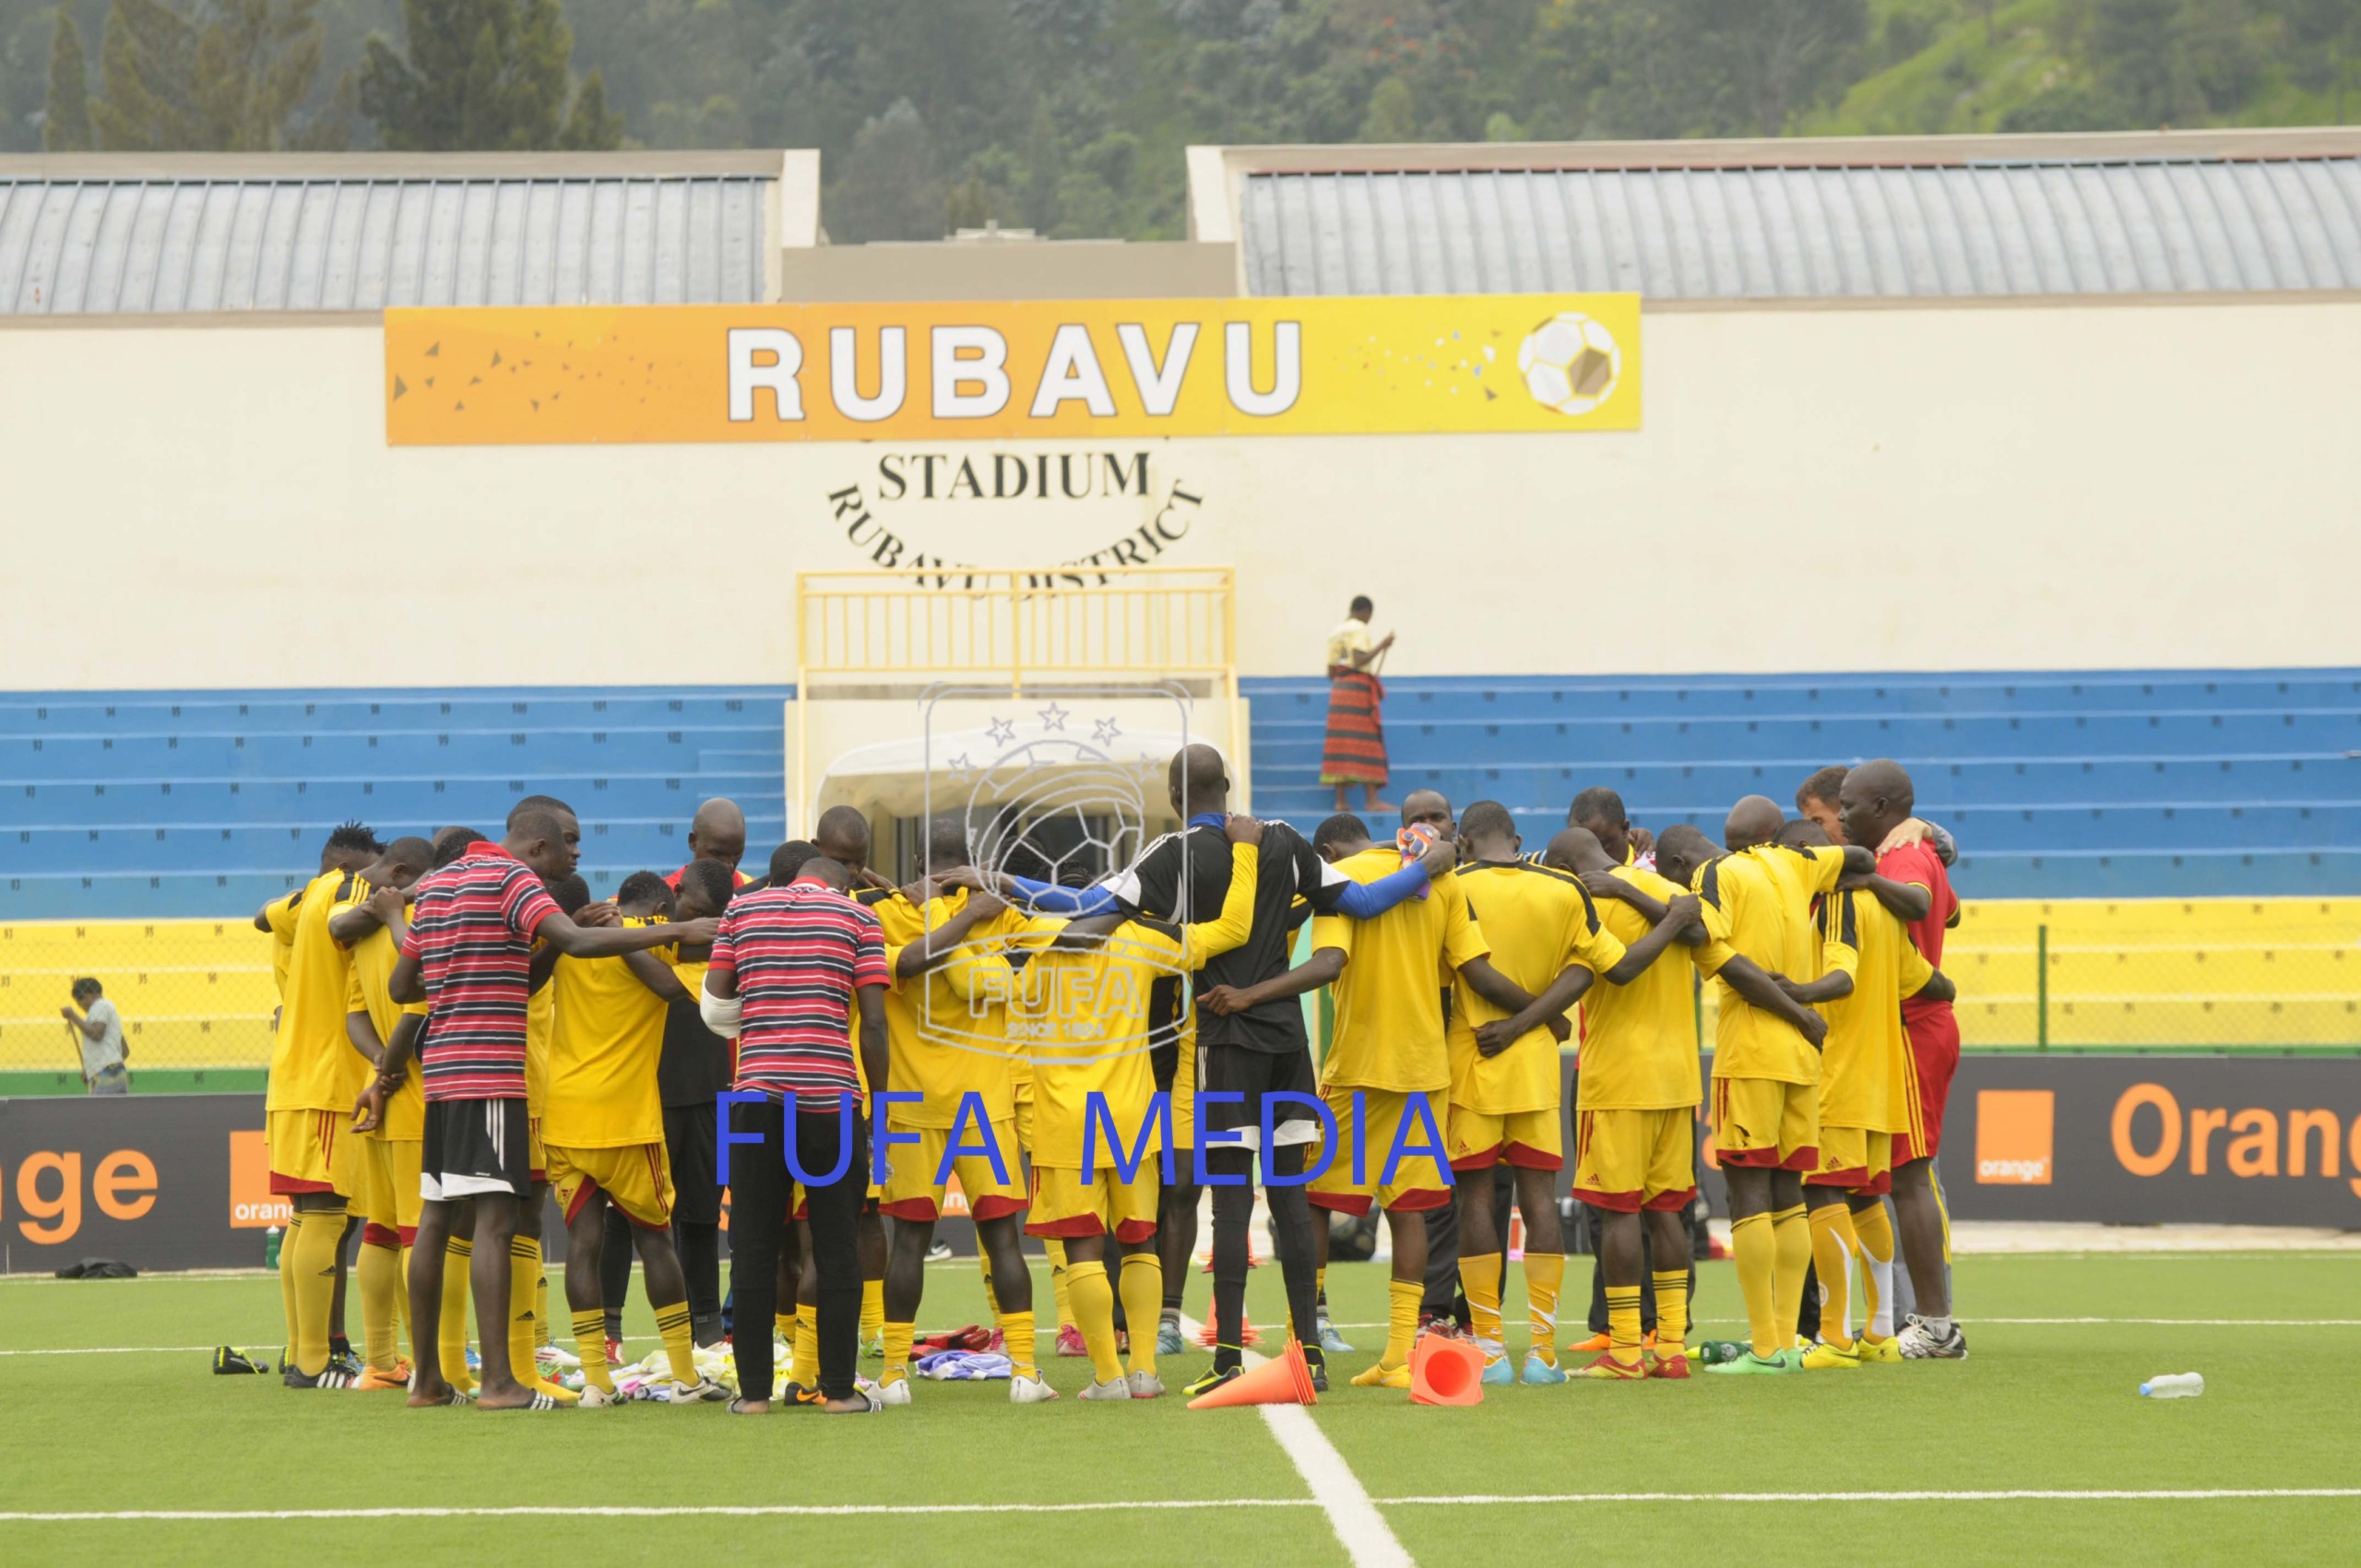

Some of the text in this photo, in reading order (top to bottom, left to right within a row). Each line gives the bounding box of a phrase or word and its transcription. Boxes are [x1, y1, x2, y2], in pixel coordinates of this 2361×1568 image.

[727, 321, 1302, 422] RUBAVU
[877, 452, 1152, 500] STADIUM
[1979, 1159, 2046, 1182] orange
[2110, 1082, 2361, 1200] Oran
[0, 1149, 159, 1245] ge
